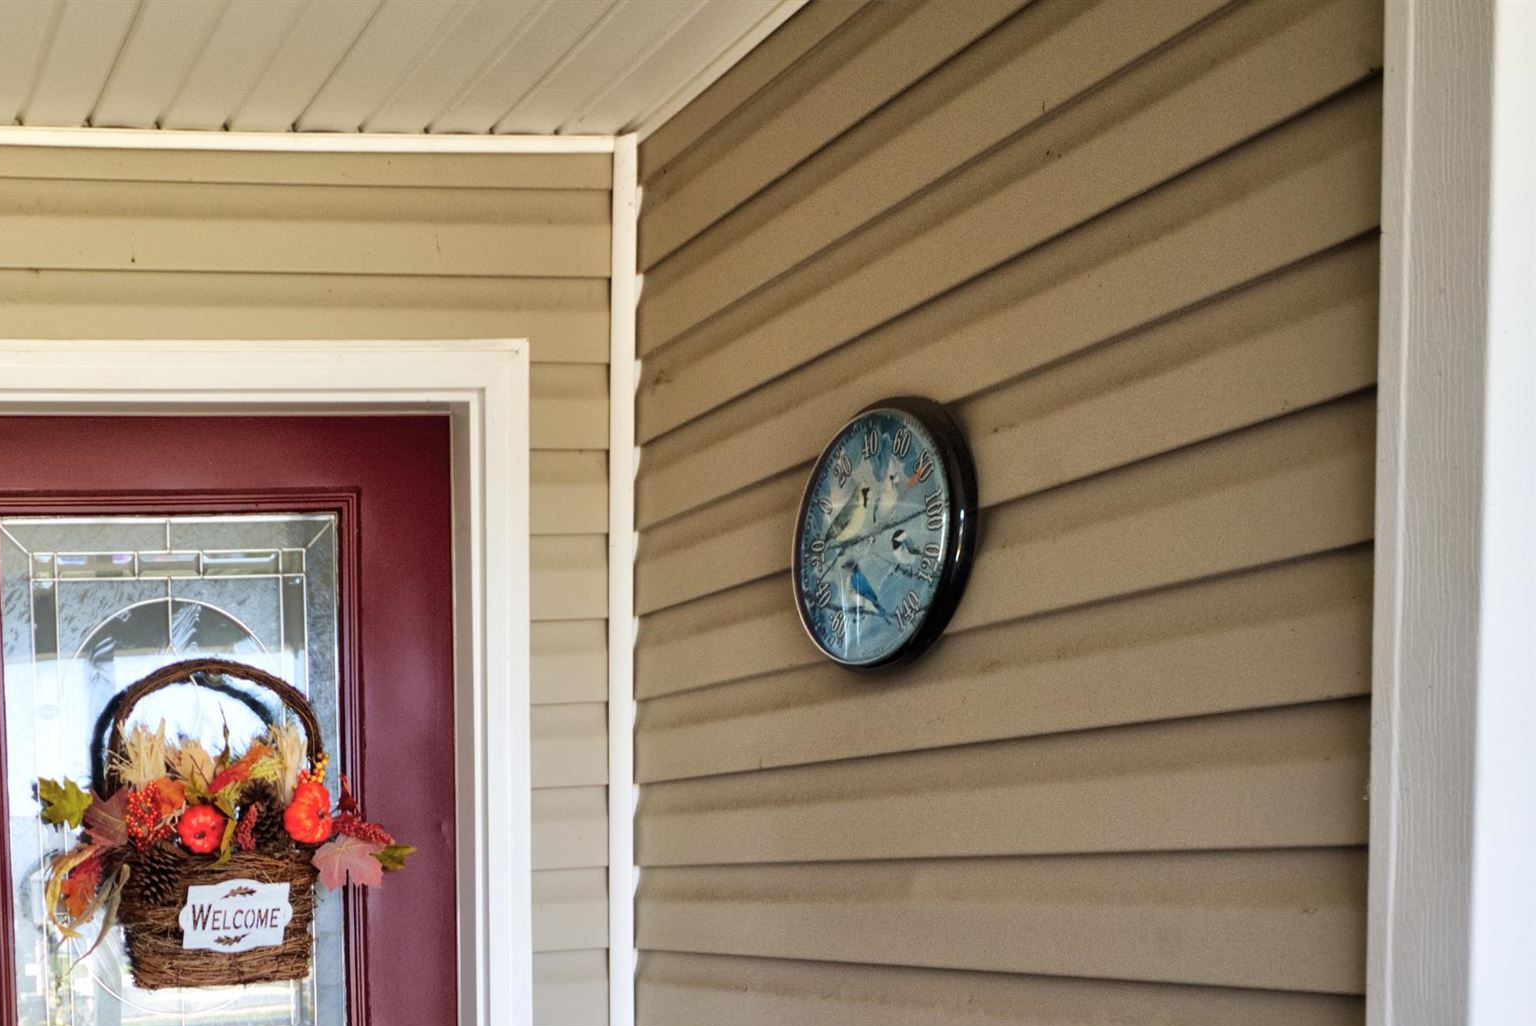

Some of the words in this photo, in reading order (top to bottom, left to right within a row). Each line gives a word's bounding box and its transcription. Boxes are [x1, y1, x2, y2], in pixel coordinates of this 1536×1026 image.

[860, 430, 879, 459] 40
[892, 428, 913, 459] 60
[833, 453, 852, 489] 20
[914, 448, 935, 482] 80
[924, 487, 944, 530] 100
[918, 543, 941, 584] 120
[894, 590, 921, 632] 140
[191, 903, 281, 931] WELCOME
